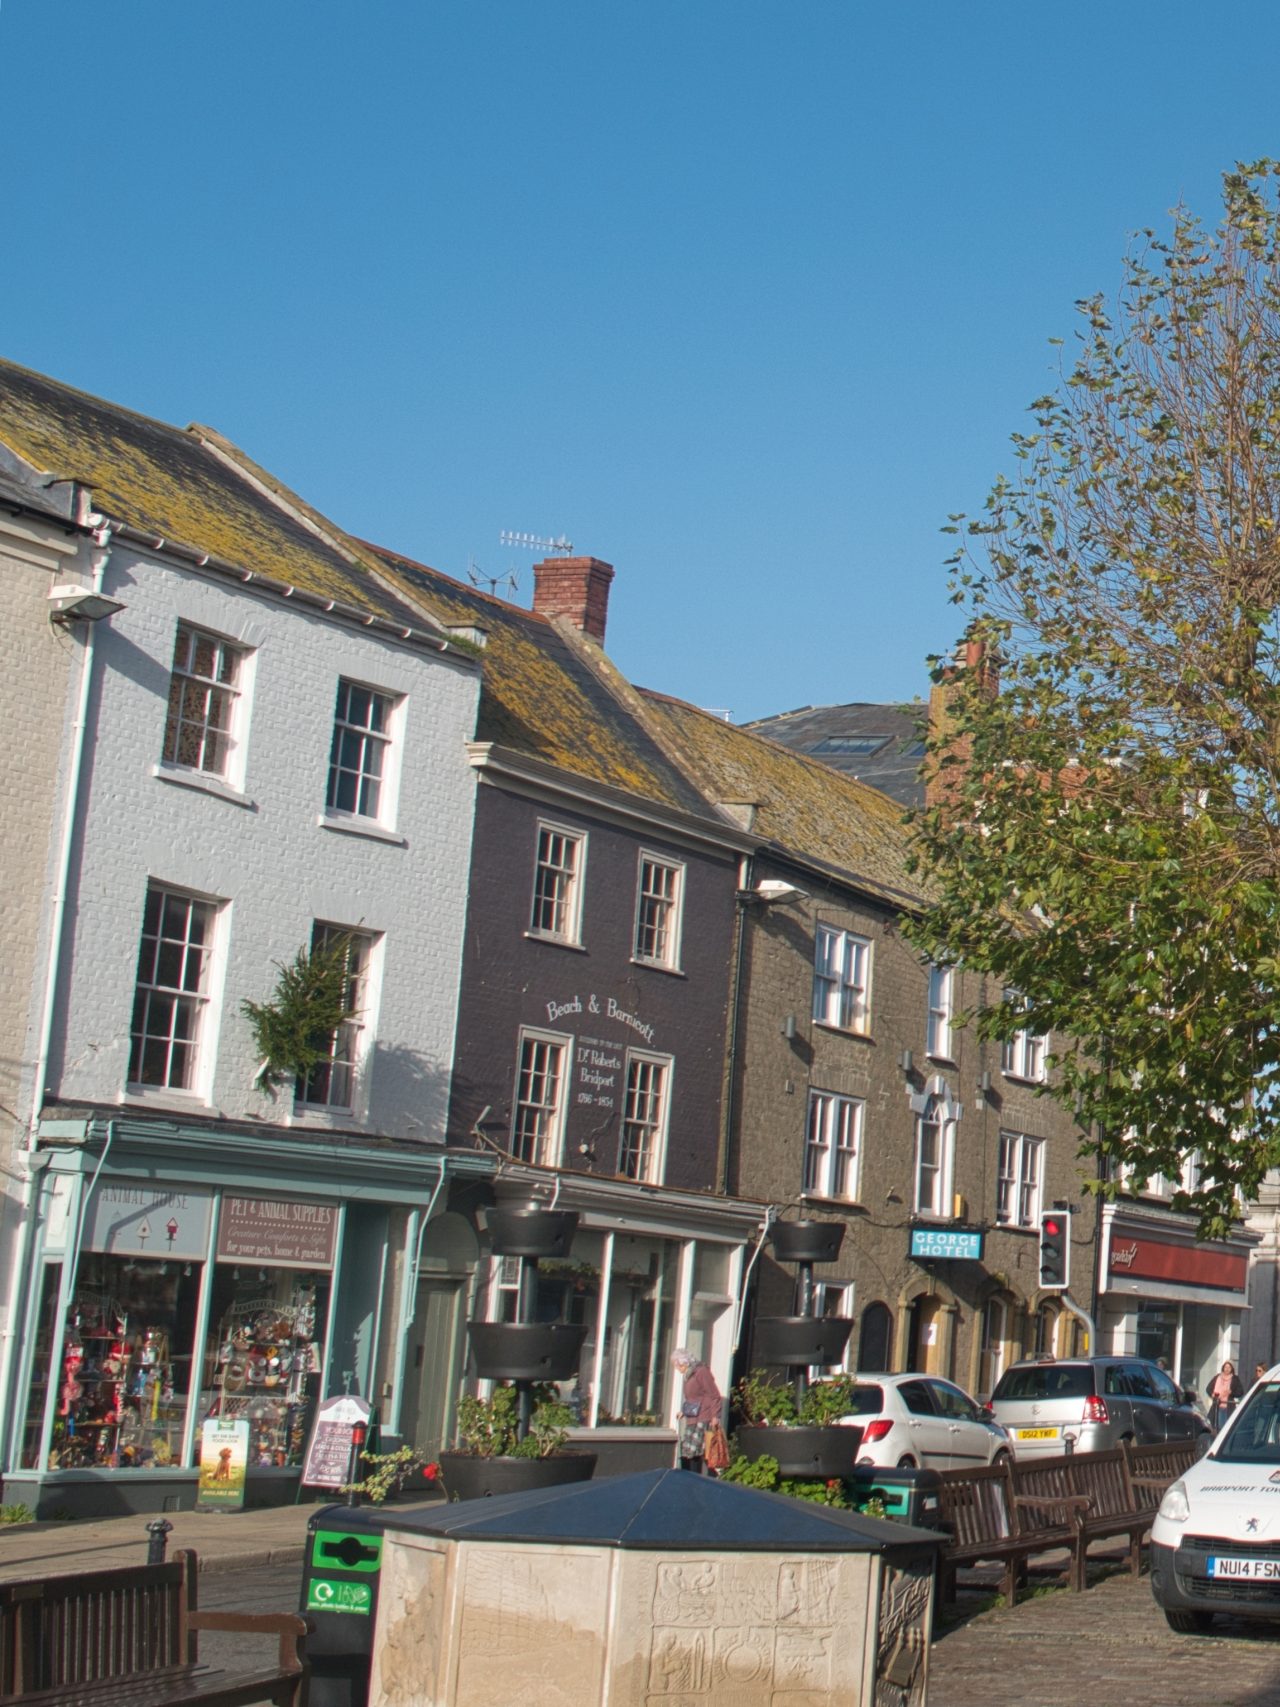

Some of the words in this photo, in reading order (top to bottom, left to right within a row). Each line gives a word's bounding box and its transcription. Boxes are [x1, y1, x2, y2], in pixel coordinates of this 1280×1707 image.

[546, 995, 582, 1022] Beach
[588, 993, 600, 1014] &
[606, 997, 655, 1043] Barnicott
[590, 1049, 621, 1069] Roberts
[580, 1067, 615, 1091] Bridport
[101, 1184, 146, 1206] ANIMAL
[152, 1190, 189, 1210] HOUSE
[231, 1198, 248, 1216] PET
[249, 1200, 257, 1214] &
[258, 1201, 290, 1221] ANIMAL
[292, 1204, 332, 1225] SUPPLIES
[915, 1232, 978, 1247] GEORGE
[226, 1240, 238, 1253] for
[238, 1243, 256, 1255] your
[274, 1243, 293, 1257] home
[301, 1248, 327, 1261] garden
[919, 1244, 971, 1258] HOTEL
[1219, 1561, 1250, 1576] NU14
